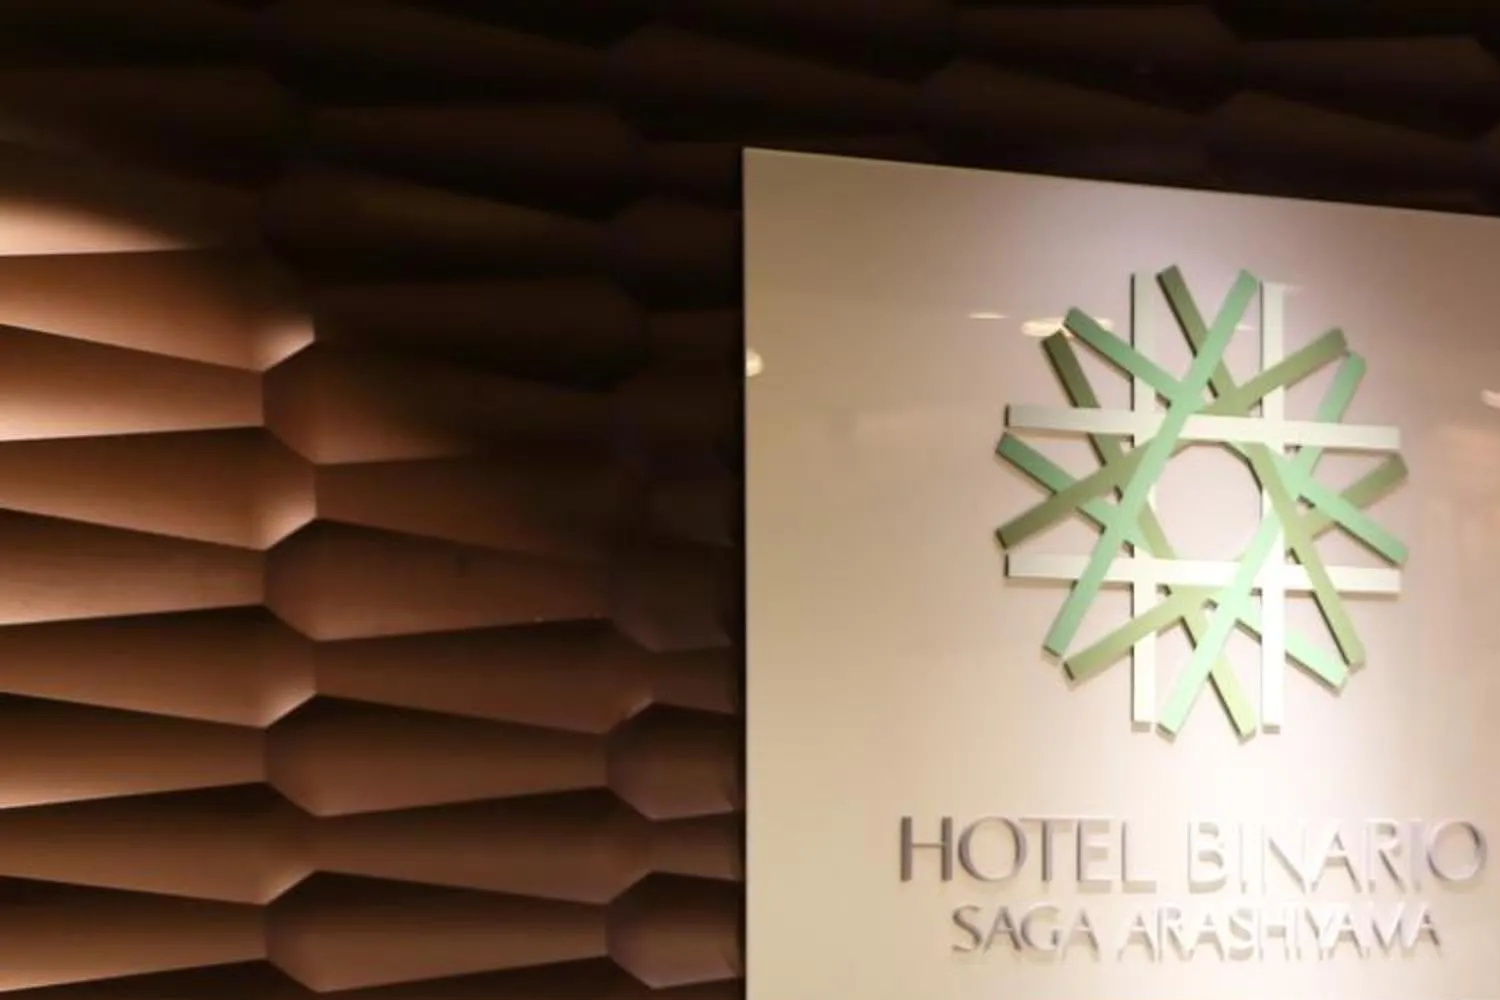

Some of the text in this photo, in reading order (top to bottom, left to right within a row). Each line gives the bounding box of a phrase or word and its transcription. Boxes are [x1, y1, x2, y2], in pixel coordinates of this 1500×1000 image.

[898, 815, 1486, 893] HOTEL BINARIO
[951, 904, 1443, 962] SAGA ARASHIYAMA
